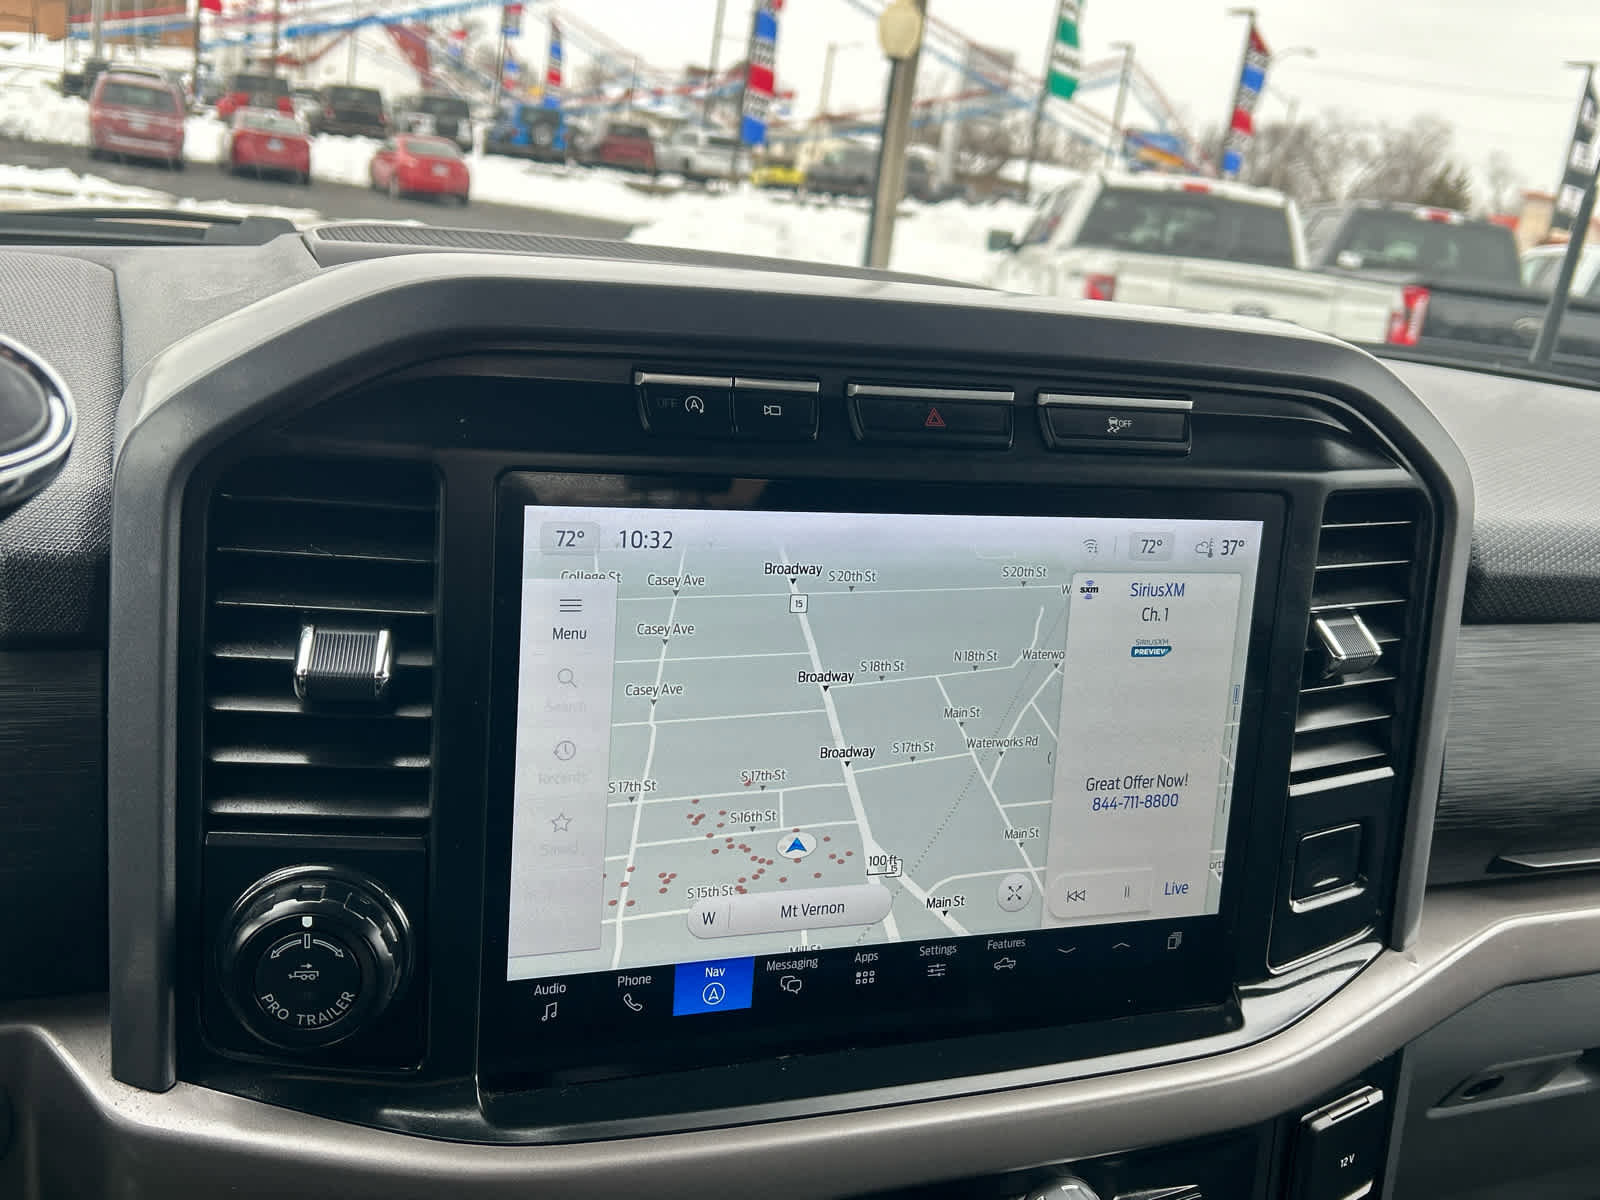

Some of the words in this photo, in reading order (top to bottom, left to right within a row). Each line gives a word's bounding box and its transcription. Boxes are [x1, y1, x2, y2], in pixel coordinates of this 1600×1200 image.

[555, 530, 585, 547] 72°
[619, 530, 674, 549] 10:32
[1140, 539, 1163, 554] 72°
[1220, 540, 1245, 555] 37°
[764, 562, 823, 577] Broadway
[1002, 567, 1009, 577] S
[1010, 567, 1034, 577] 20th
[1035, 567, 1047, 577] St
[647, 574, 681, 588] Casey
[683, 575, 705, 586] Ave
[828, 571, 836, 582] S
[837, 571, 863, 582] 20th
[864, 571, 876, 582] St
[1130, 582, 1185, 598] SiriusXM
[795, 600, 803, 608] 15
[1141, 607, 1162, 622] Ch.
[1164, 607, 1169, 622] 1
[552, 628, 587, 641] Menu
[637, 624, 669, 637] Casey
[672, 624, 695, 635] Ave
[954, 652, 962, 662] N
[964, 651, 985, 661] 18th
[986, 651, 998, 661] St
[860, 661, 867, 672] S
[869, 661, 891, 672] 18th
[893, 661, 905, 671] St
[798, 671, 854, 685] Broadway
[625, 684, 659, 697] Casey
[661, 684, 683, 696] Ave
[943, 708, 968, 719] Main
[968, 707, 980, 718] St
[893, 743, 900, 753] S
[901, 742, 924, 753] 17th
[925, 742, 934, 752] St
[966, 737, 1023, 749] Waterworks
[1024, 736, 1038, 747] Rd
[820, 746, 875, 759] Broadway
[741, 770, 749, 782] S
[751, 770, 772, 781] 17th
[774, 769, 785, 780] St
[608, 782, 616, 793] S
[618, 780, 641, 792] 17th
[643, 780, 656, 791] St
[1086, 777, 1121, 792] Great
[1123, 775, 1154, 790] Offer
[1156, 773, 1188, 788] Now!
[1092, 793, 1179, 812] 844-711-8800
[730, 812, 737, 823] S
[740, 811, 763, 823] 16th
[765, 810, 776, 821] St
[1004, 829, 1027, 840] Main
[1027, 828, 1039, 839] St
[869, 855, 887, 866] 100
[889, 854, 897, 865] ft
[688, 888, 695, 898] S
[697, 887, 720, 897] 15th
[721, 886, 733, 896] St
[1164, 882, 1189, 896] Live
[926, 897, 950, 909] Main
[951, 896, 965, 907] St
[781, 905, 799, 918] Mt
[801, 903, 845, 917] Vernon
[702, 912, 715, 925] W
[919, 944, 957, 956] Settings
[987, 938, 1026, 950] Features
[766, 957, 818, 972] Messaging
[854, 952, 879, 965] Apps
[705, 967, 726, 978] Nav
[617, 975, 652, 987] Phone
[534, 984, 566, 996] Audio
[261, 992, 290, 1020] PRO
[296, 991, 356, 1026] TRAILER
